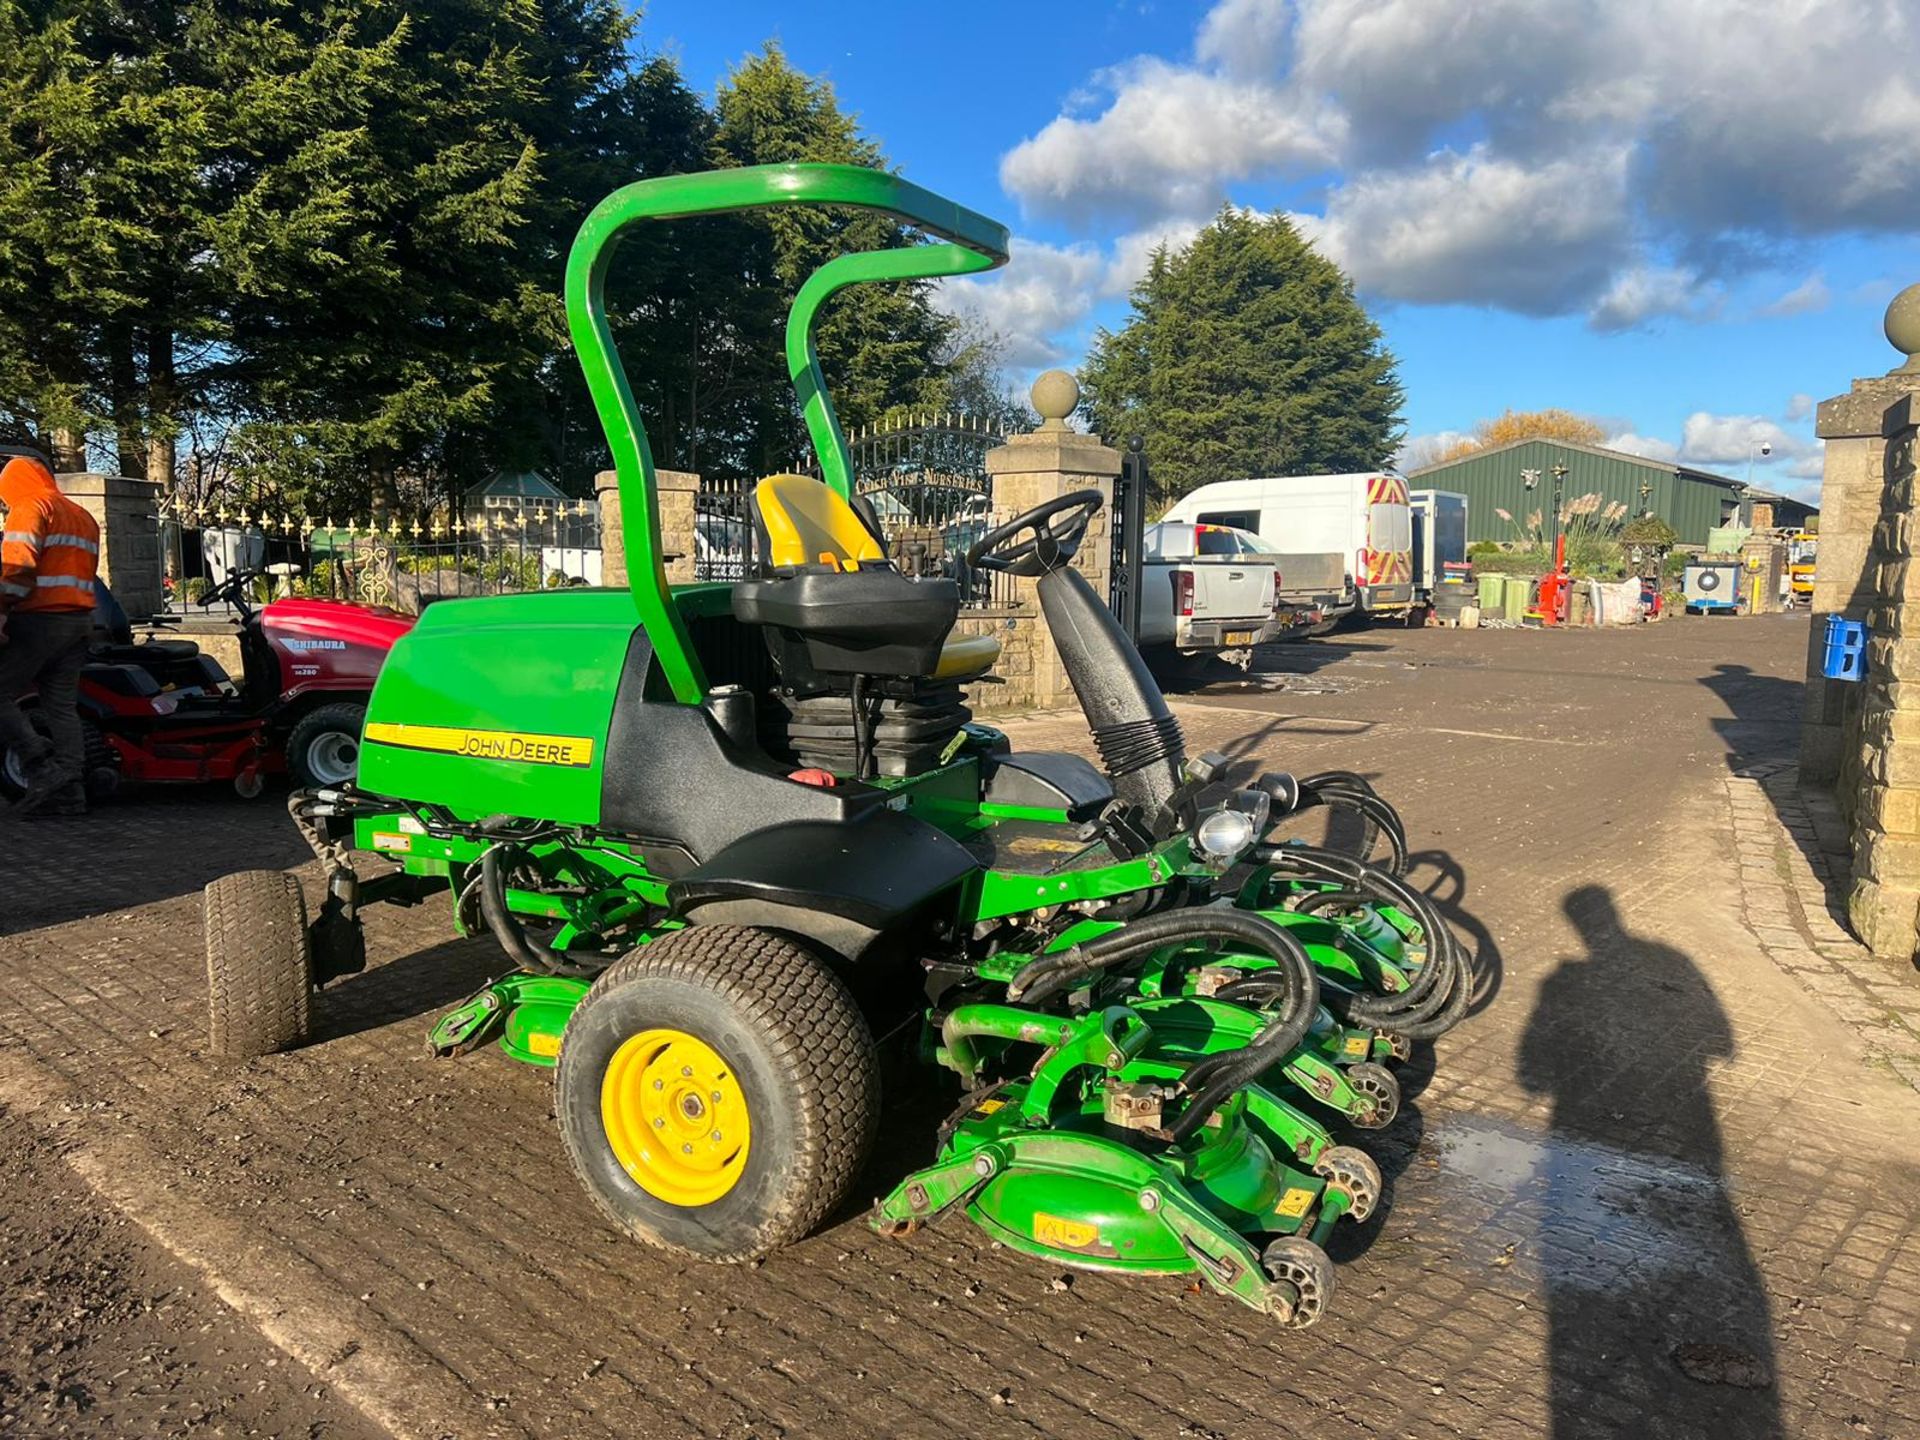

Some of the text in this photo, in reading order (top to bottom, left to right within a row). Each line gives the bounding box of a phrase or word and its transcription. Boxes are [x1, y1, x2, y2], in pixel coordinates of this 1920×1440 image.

[923, 467, 983, 492] NURSERIES
[292, 640, 346, 650] SHIBAURA
[458, 733, 573, 762] JOHN DEERE
